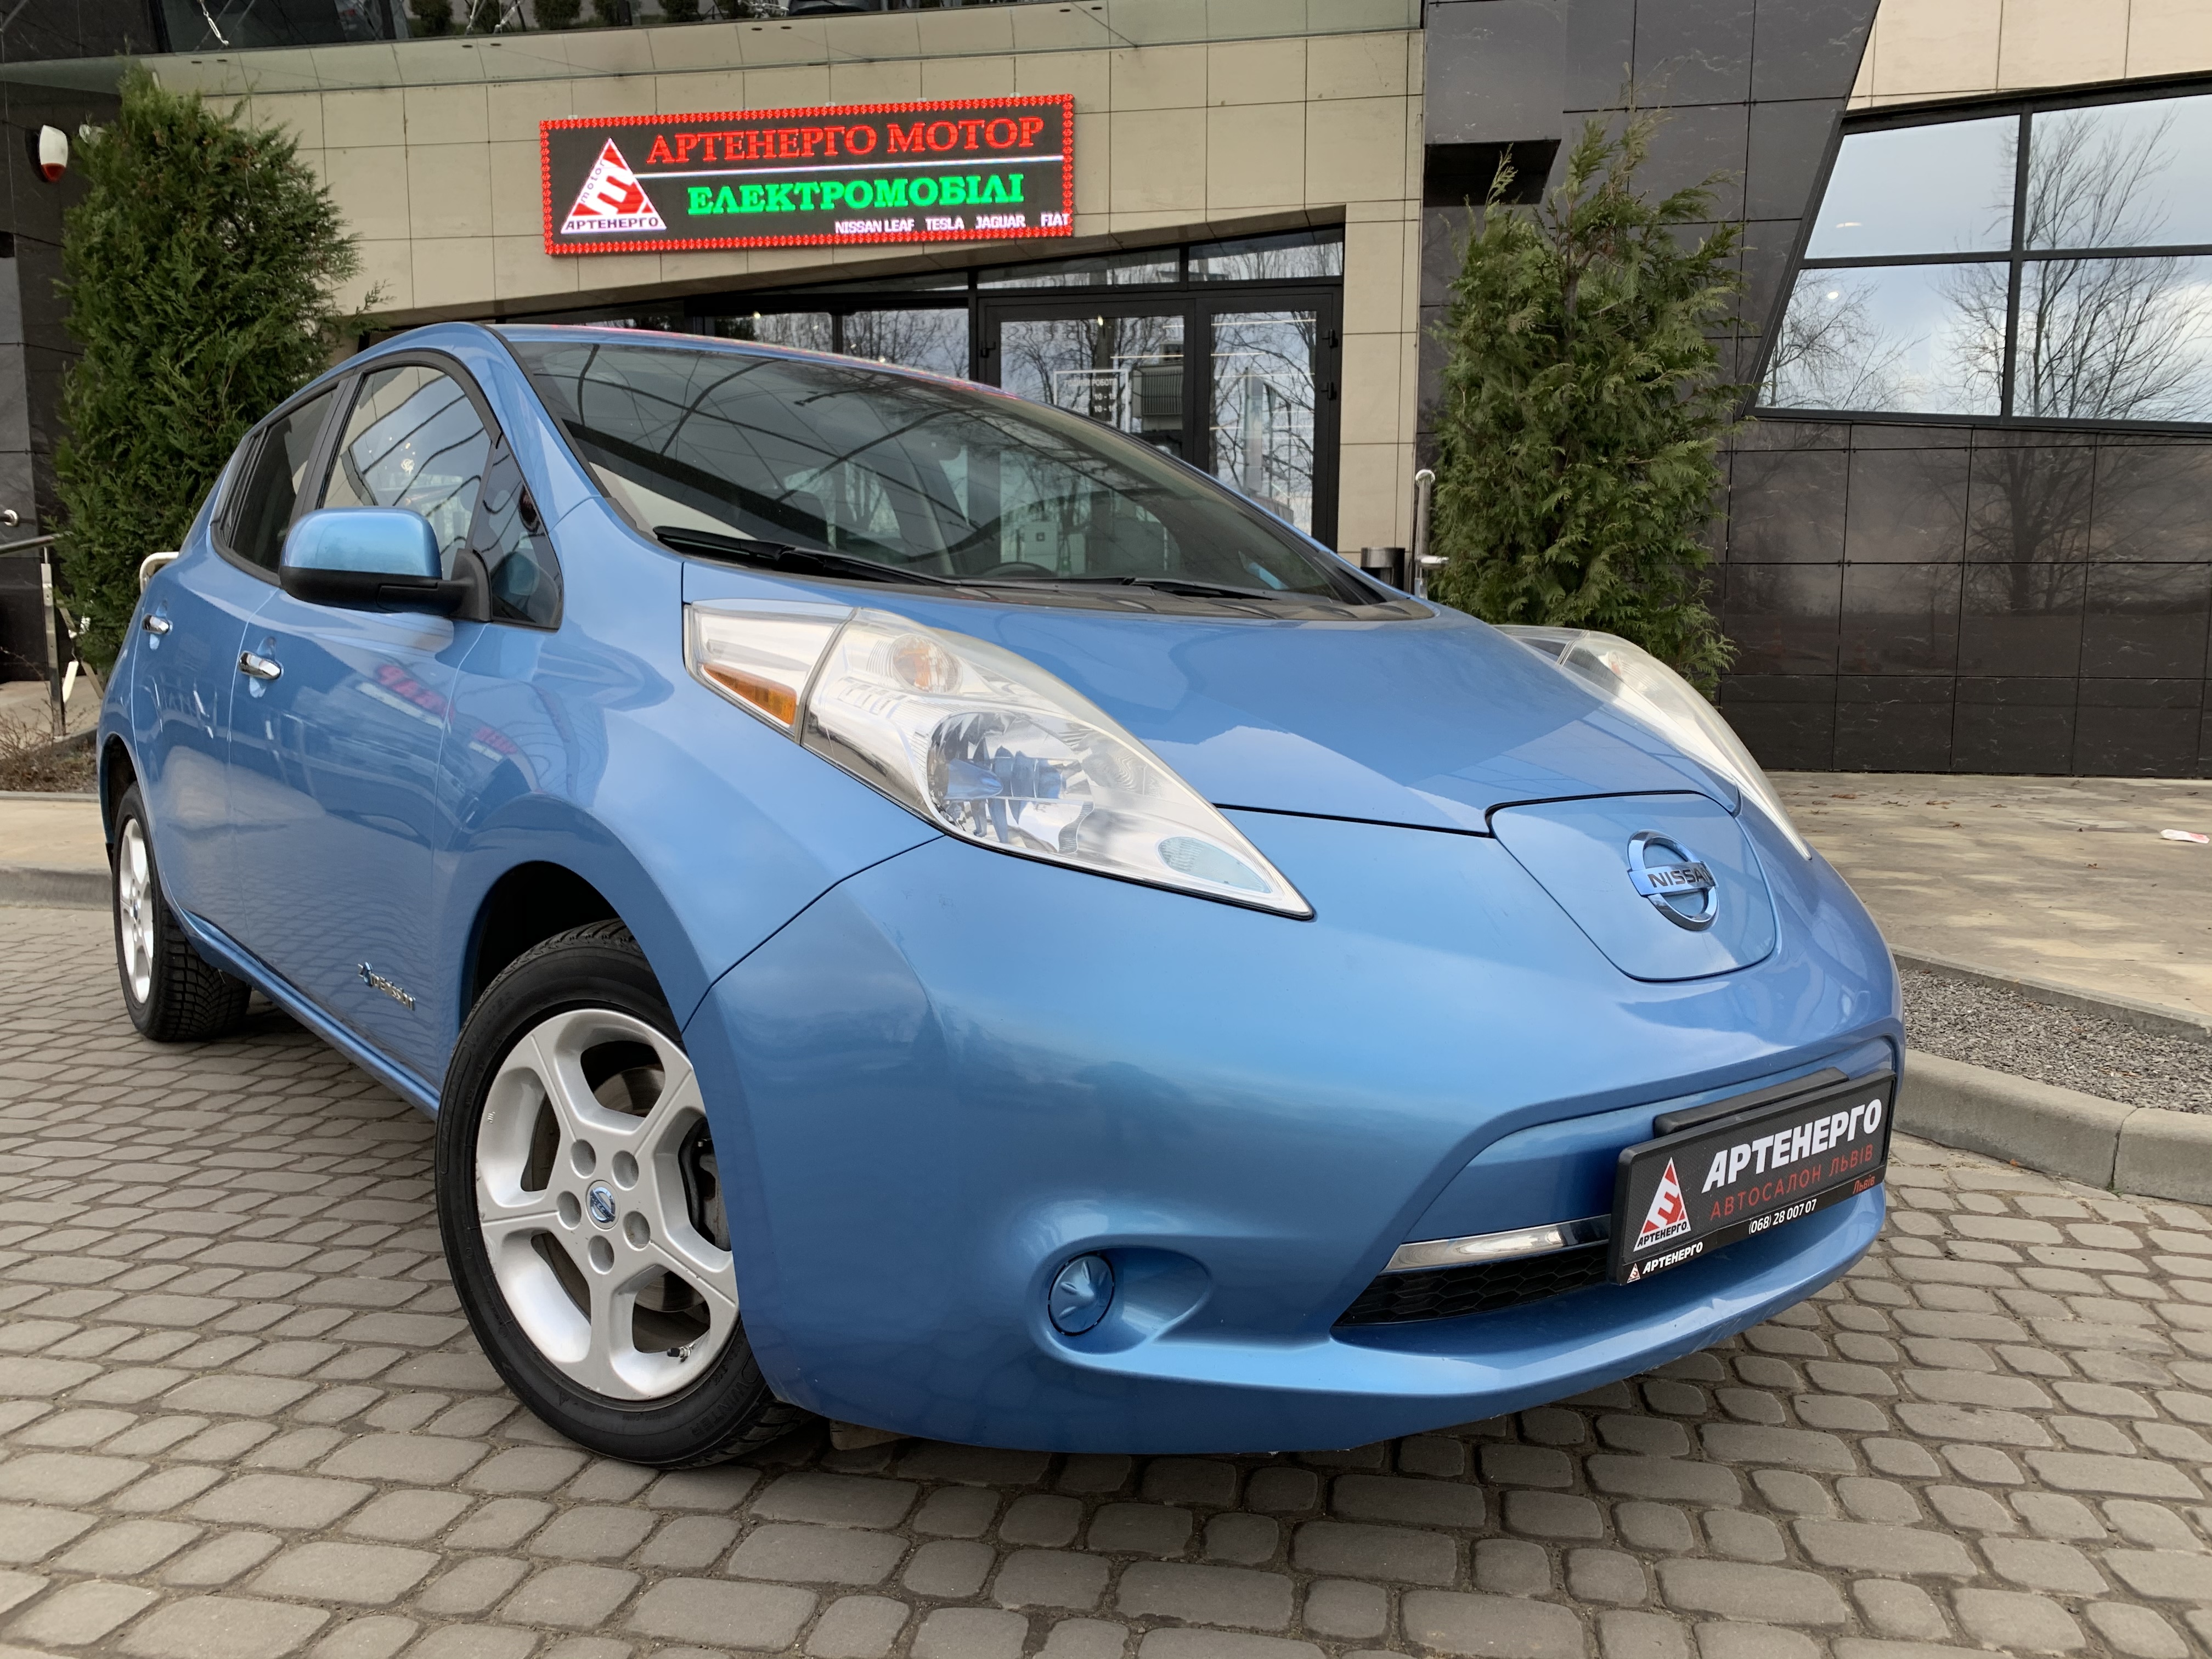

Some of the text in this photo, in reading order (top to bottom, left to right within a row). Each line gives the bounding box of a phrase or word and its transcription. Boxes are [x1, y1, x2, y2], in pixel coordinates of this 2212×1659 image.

[646, 117, 1044, 164] АРТЕНЕРГО МОТОР
[580, 159, 605, 203] motor
[687, 174, 1024, 215] ЕЛЕКТРОМОБІЛІ
[565, 217, 659, 230] АРТЕНЕРГО
[835, 211, 1069, 234] NISSAN LEAF TESLA JAGUAR FIAT
[1647, 867, 1713, 888] NISSAN
[1701, 1099, 1882, 1194] АРТЕНЕРГО
[1711, 1144, 1873, 1220] АВТОСАЛОН ЛЬВІВ
[1749, 1199, 1817, 1234] (068) 28 007 07
[1637, 1221, 1687, 1248] АРТЕНЕРГО
[1643, 1242, 1703, 1274] АРТЕНЕРГО
